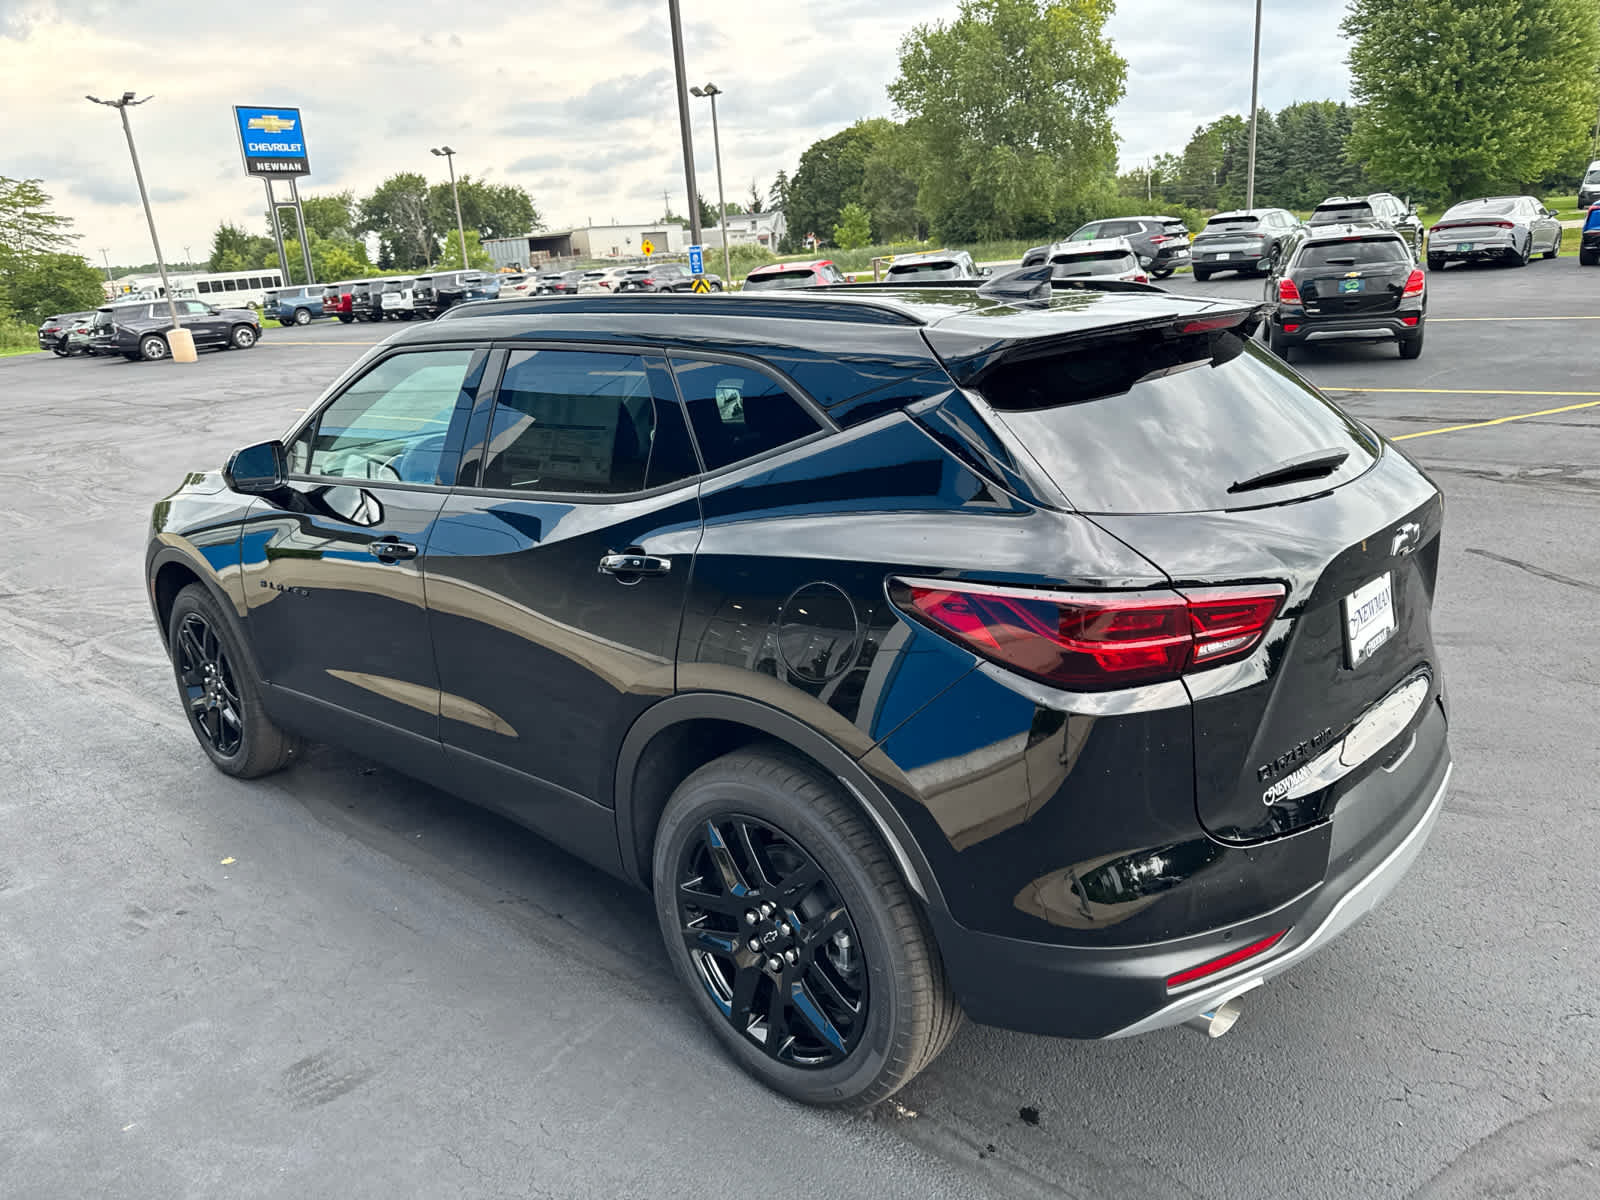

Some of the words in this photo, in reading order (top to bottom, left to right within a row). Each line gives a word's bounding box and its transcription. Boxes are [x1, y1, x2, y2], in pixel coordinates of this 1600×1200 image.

[248, 142, 302, 152] CHEVROLET
[256, 162, 302, 171] NEWMAN
[1348, 586, 1391, 641] NEWMAN
[1263, 763, 1313, 806] NEWMAN
